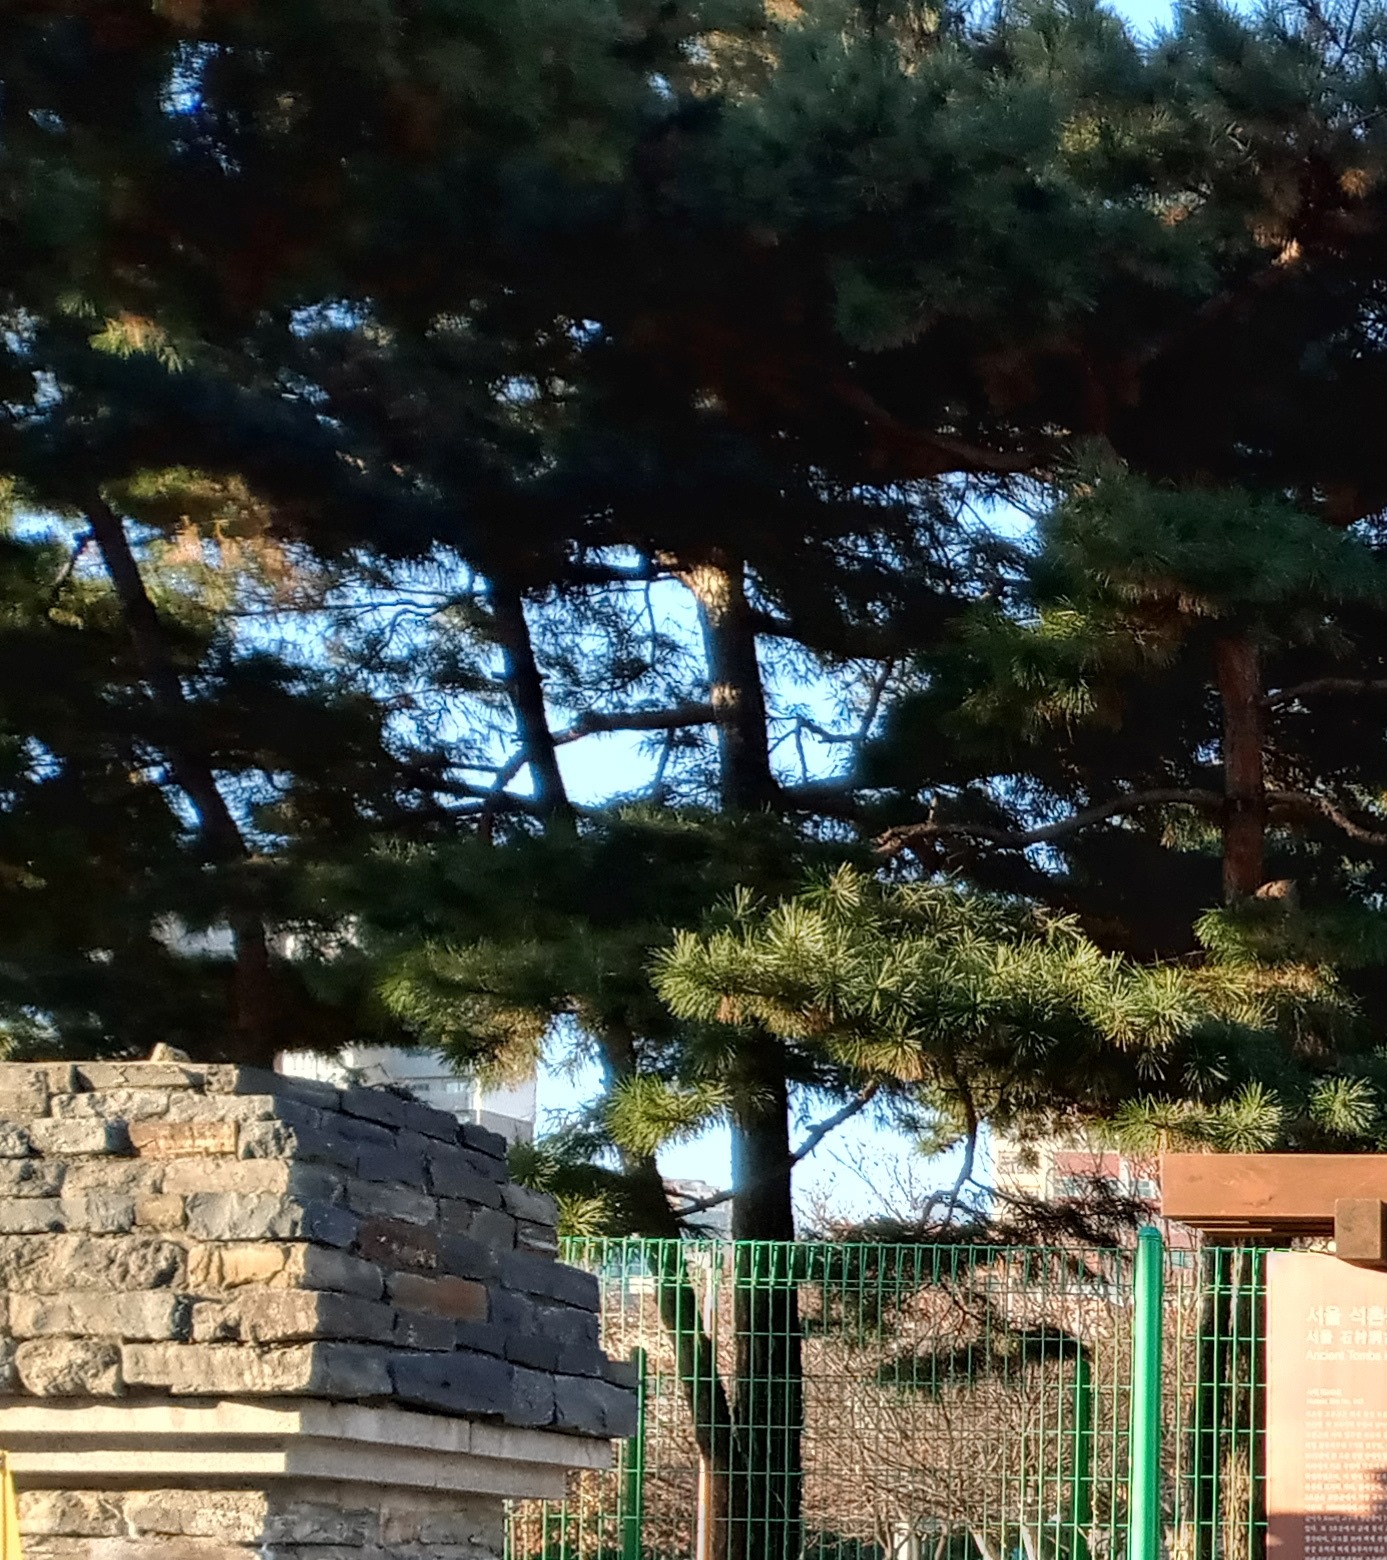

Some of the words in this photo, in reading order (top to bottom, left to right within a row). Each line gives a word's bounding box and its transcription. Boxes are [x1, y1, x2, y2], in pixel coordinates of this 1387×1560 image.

[1305, 1304, 1340, 1326] 서울
[1305, 1349, 1344, 1361] Ancient
[1347, 1349, 1381, 1361] Tombs
